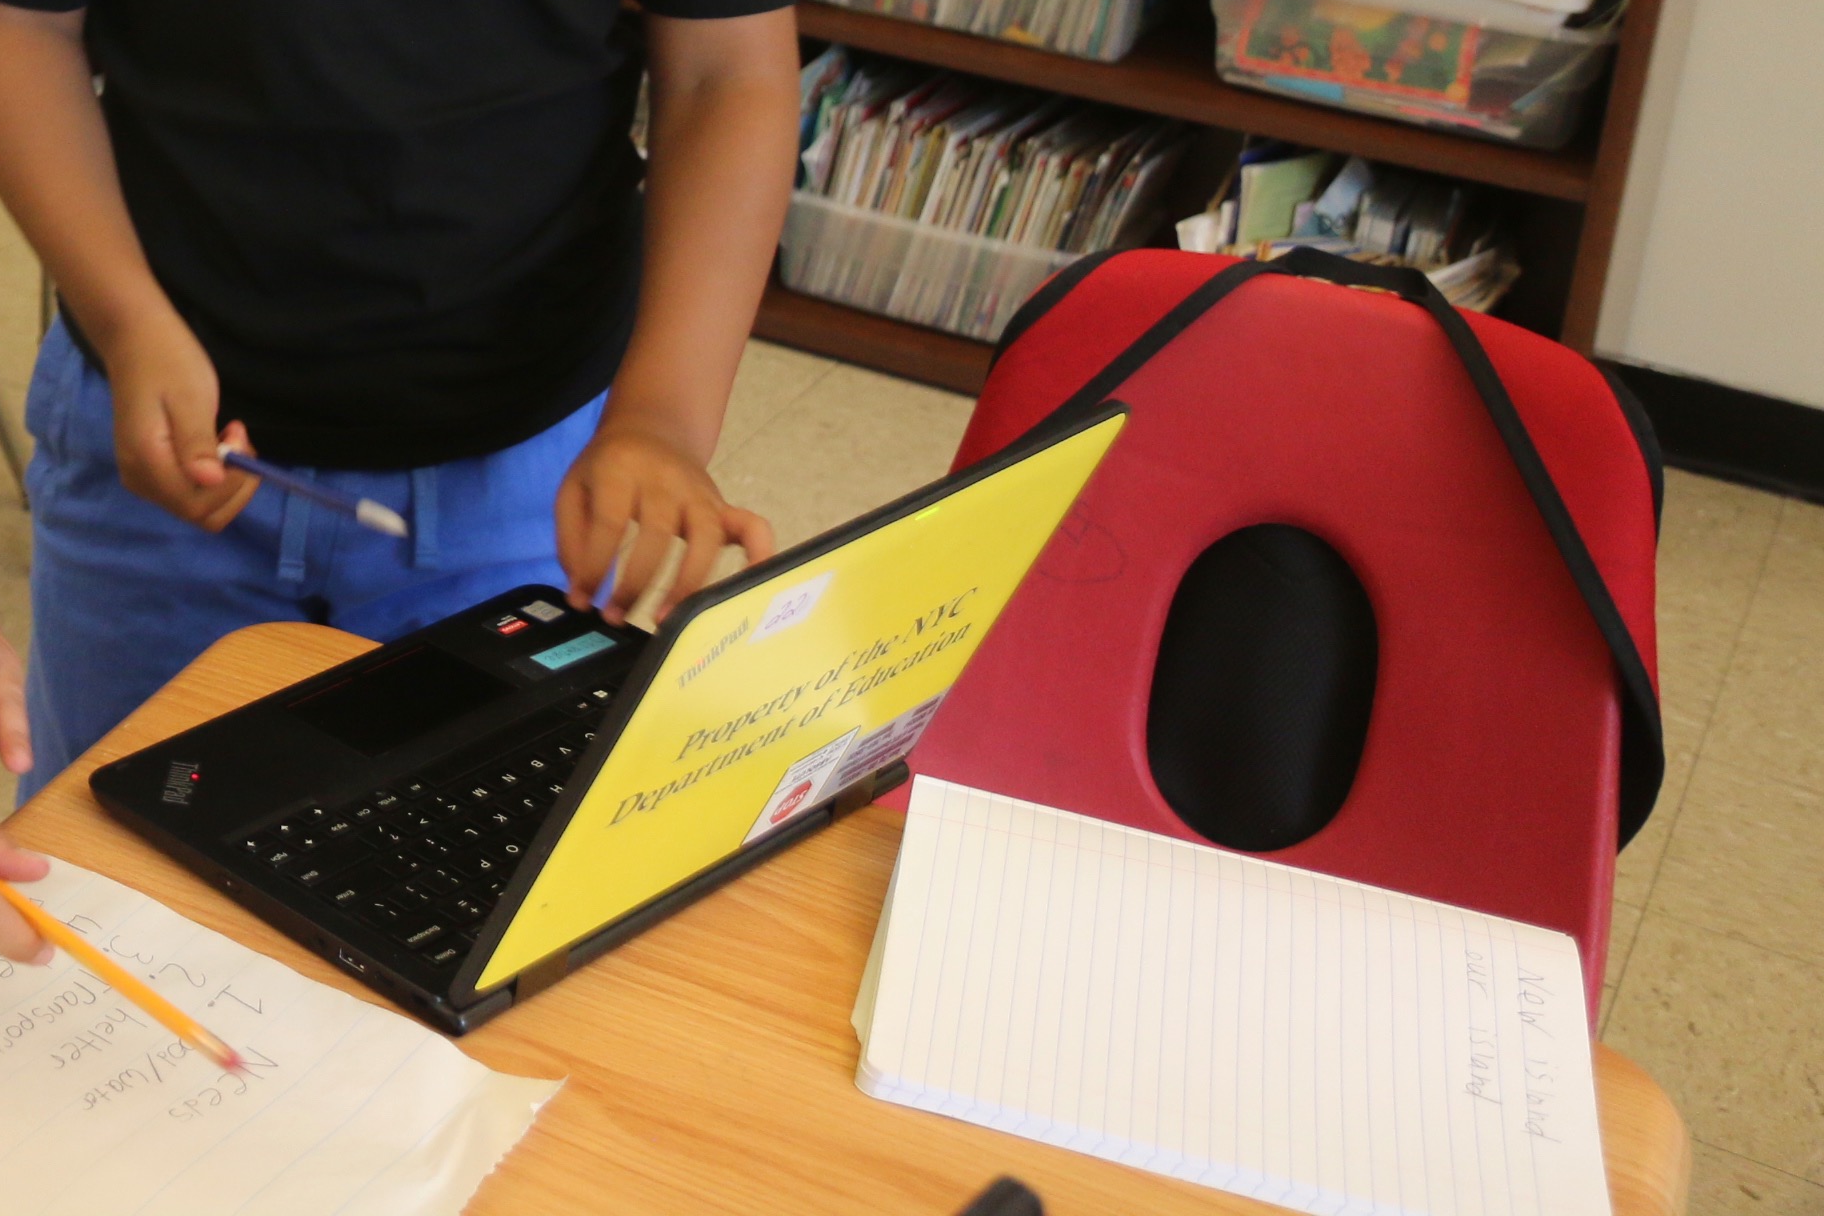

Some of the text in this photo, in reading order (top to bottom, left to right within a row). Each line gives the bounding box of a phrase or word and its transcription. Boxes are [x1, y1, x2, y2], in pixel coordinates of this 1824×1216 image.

[677, 615, 749, 691] ThinkPad
[671, 674, 813, 764] Property
[813, 650, 858, 692] of
[852, 634, 900, 671] the
[901, 587, 979, 645] NYC
[608, 716, 798, 828] Department
[798, 691, 843, 729] of
[833, 621, 973, 710] Education
[501, 773, 517, 783] N
[530, 759, 545, 769] B
[162, 761, 200, 805] ThinkPad
[471, 787, 488, 798] M
[549, 784, 564, 794] H
[492, 812, 508, 823] K
[773, 787, 807, 817] STOP
[480, 858, 492, 869] P
[101, 934, 155, 965] 3.
[50, 962, 207, 1070] 2. helter
[1463, 950, 1504, 1106] our island
[1516, 966, 1563, 1144] New island
[167, 1045, 280, 1123] Needs
